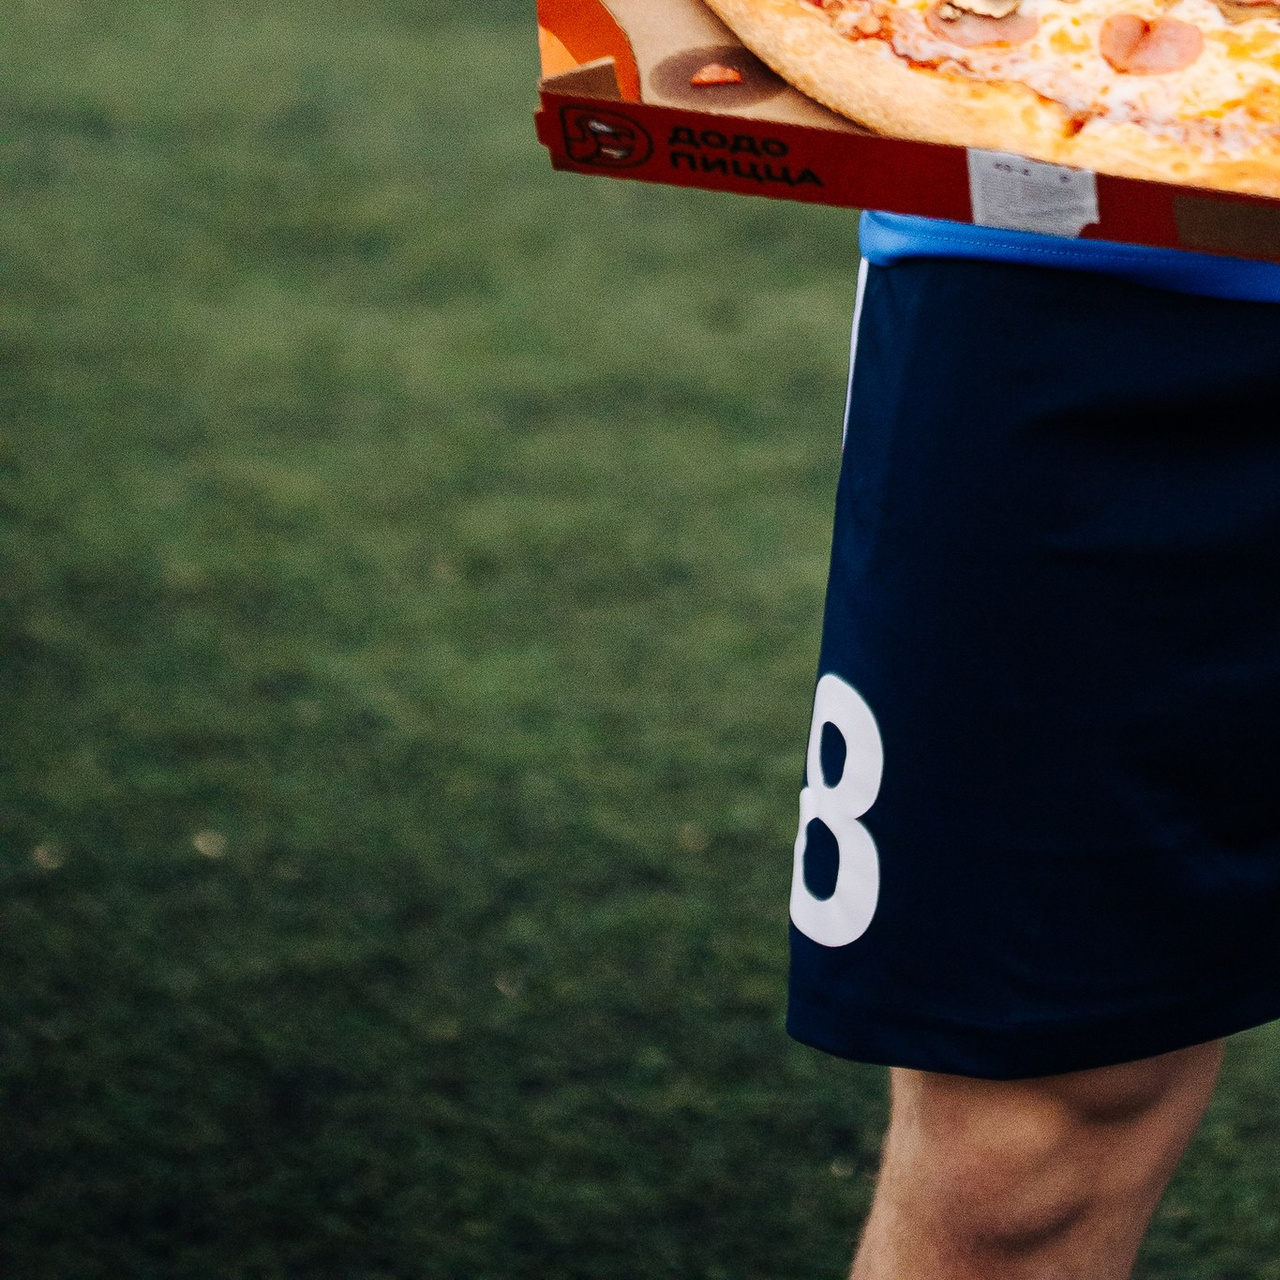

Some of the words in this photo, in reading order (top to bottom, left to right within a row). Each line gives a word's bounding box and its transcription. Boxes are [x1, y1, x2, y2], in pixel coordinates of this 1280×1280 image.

[667, 125, 789, 158] ДОДО
[669, 152, 824, 188] ПИЦЦА
[789, 673, 884, 948] 8
